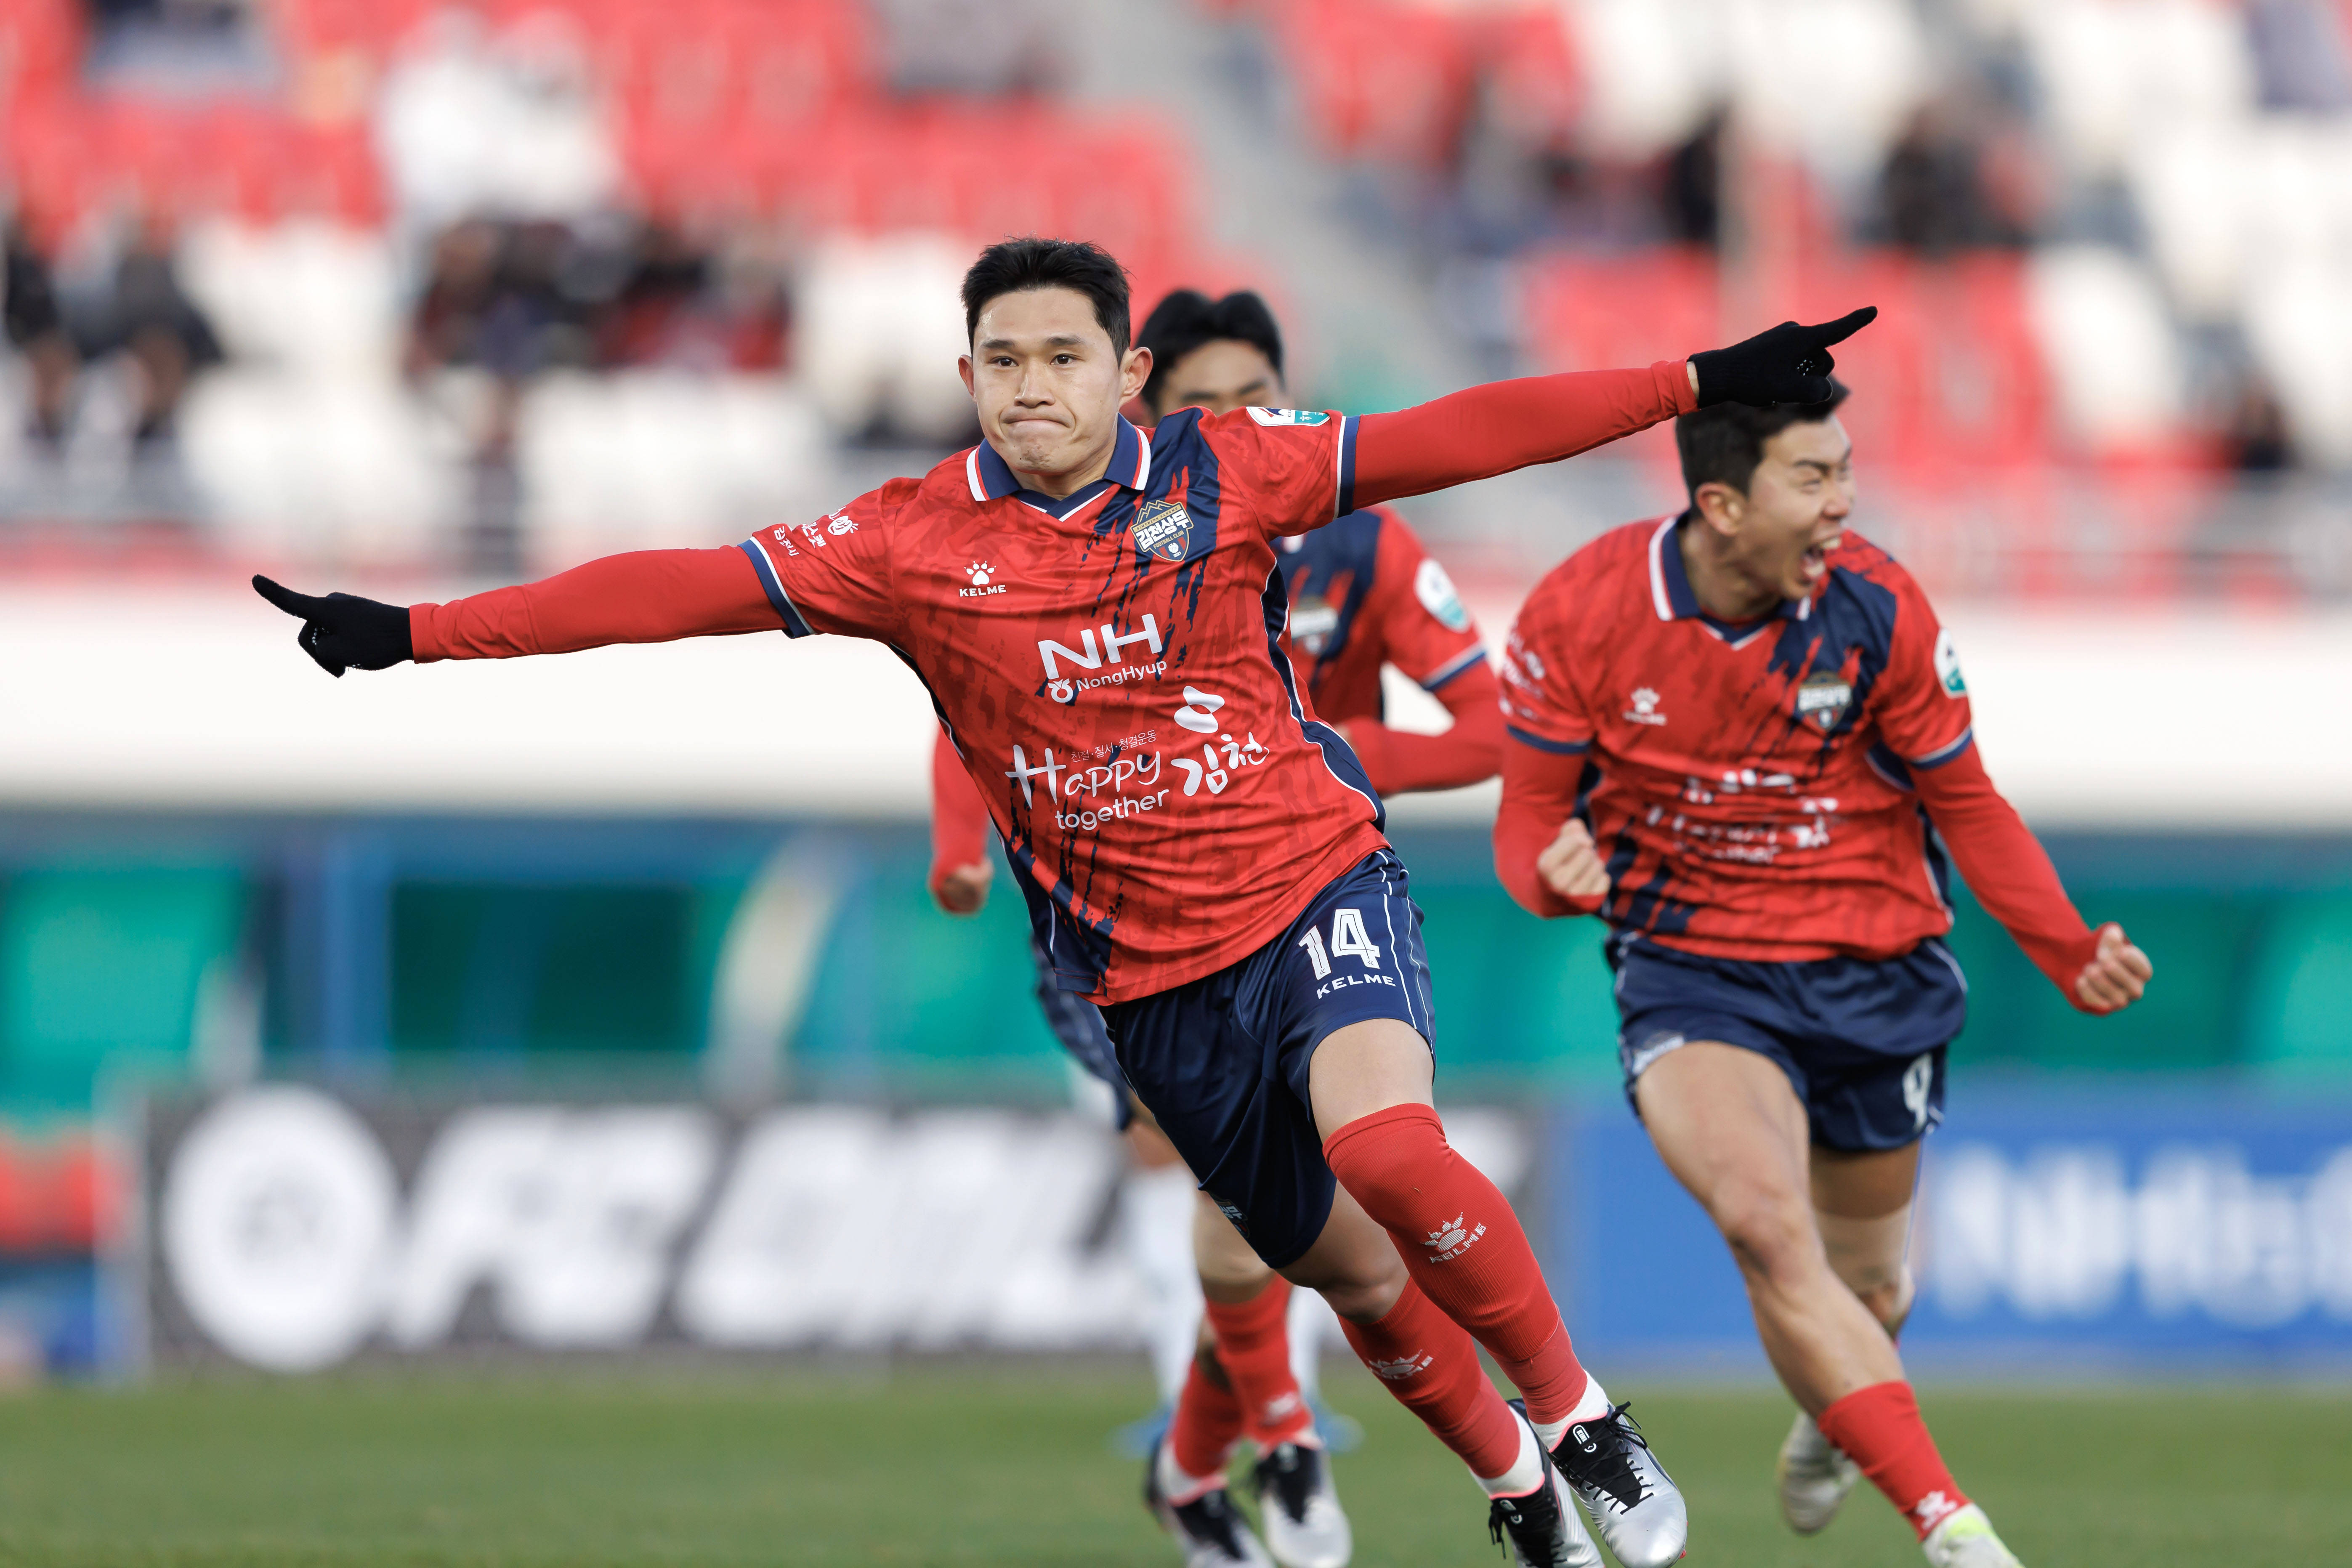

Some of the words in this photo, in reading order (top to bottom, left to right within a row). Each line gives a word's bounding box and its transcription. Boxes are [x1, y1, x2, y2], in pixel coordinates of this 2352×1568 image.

[1136, 510, 1189, 550] 김천상무
[1153, 536, 1174, 549] FOOTBALL
[1173, 530, 1184, 539] CLUB
[959, 585, 1007, 597] KELME
[1038, 613, 1162, 680] NH
[1076, 660, 1167, 692] NongHyup
[1005, 744, 1160, 809] Happy
[1171, 731, 1270, 796] 김천
[1055, 789, 1169, 830] together
[1298, 909, 1380, 980] 14
[1316, 974, 1396, 999] KELME
